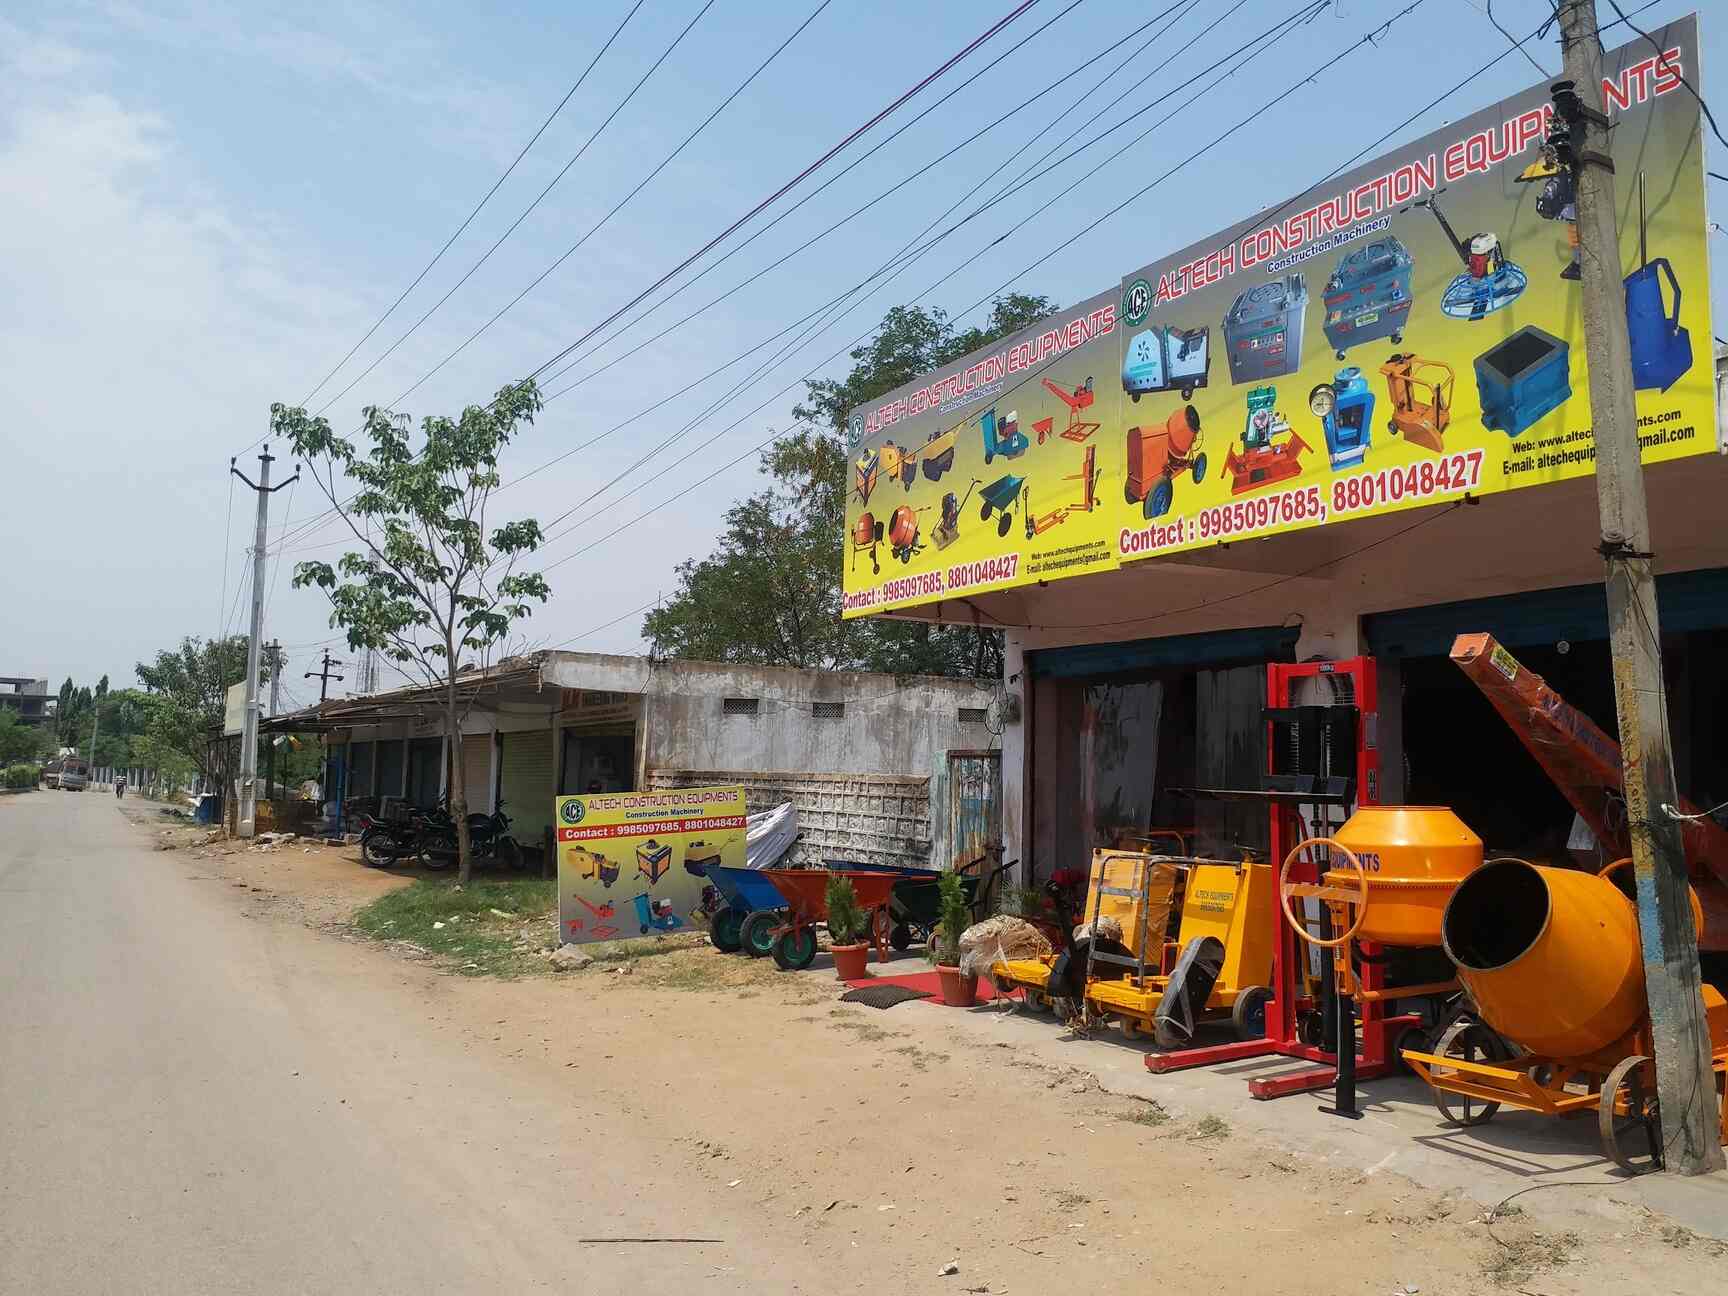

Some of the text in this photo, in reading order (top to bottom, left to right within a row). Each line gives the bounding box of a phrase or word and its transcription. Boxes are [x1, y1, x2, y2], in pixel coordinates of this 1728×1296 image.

[1154, 47, 1684, 307] ALTECH CONSTRUCTION EQUIPNTS
[1267, 214, 1392, 274] Construction Machinery
[865, 305, 1115, 433] ALTECH CONSTRUCTION EQUIPMENTS
[1503, 457, 1534, 475] E-mail:
[1512, 441, 1535, 453] Web:
[1120, 518, 1184, 554] Contact
[1200, 488, 1326, 538] 9985097685,
[1332, 451, 1482, 512] 8801048427
[842, 588, 876, 610] Contact
[882, 574, 945, 601] 9985097685,
[948, 554, 1018, 588] 8801048427
[588, 791, 738, 810] ALTECH CONSTRUCTION EQUIPMENTS
[626, 807, 704, 819] Construction Machinery
[566, 827, 608, 839] Contact
[617, 823, 682, 835] 9985097685,
[684, 817, 744, 830] 8801048427
